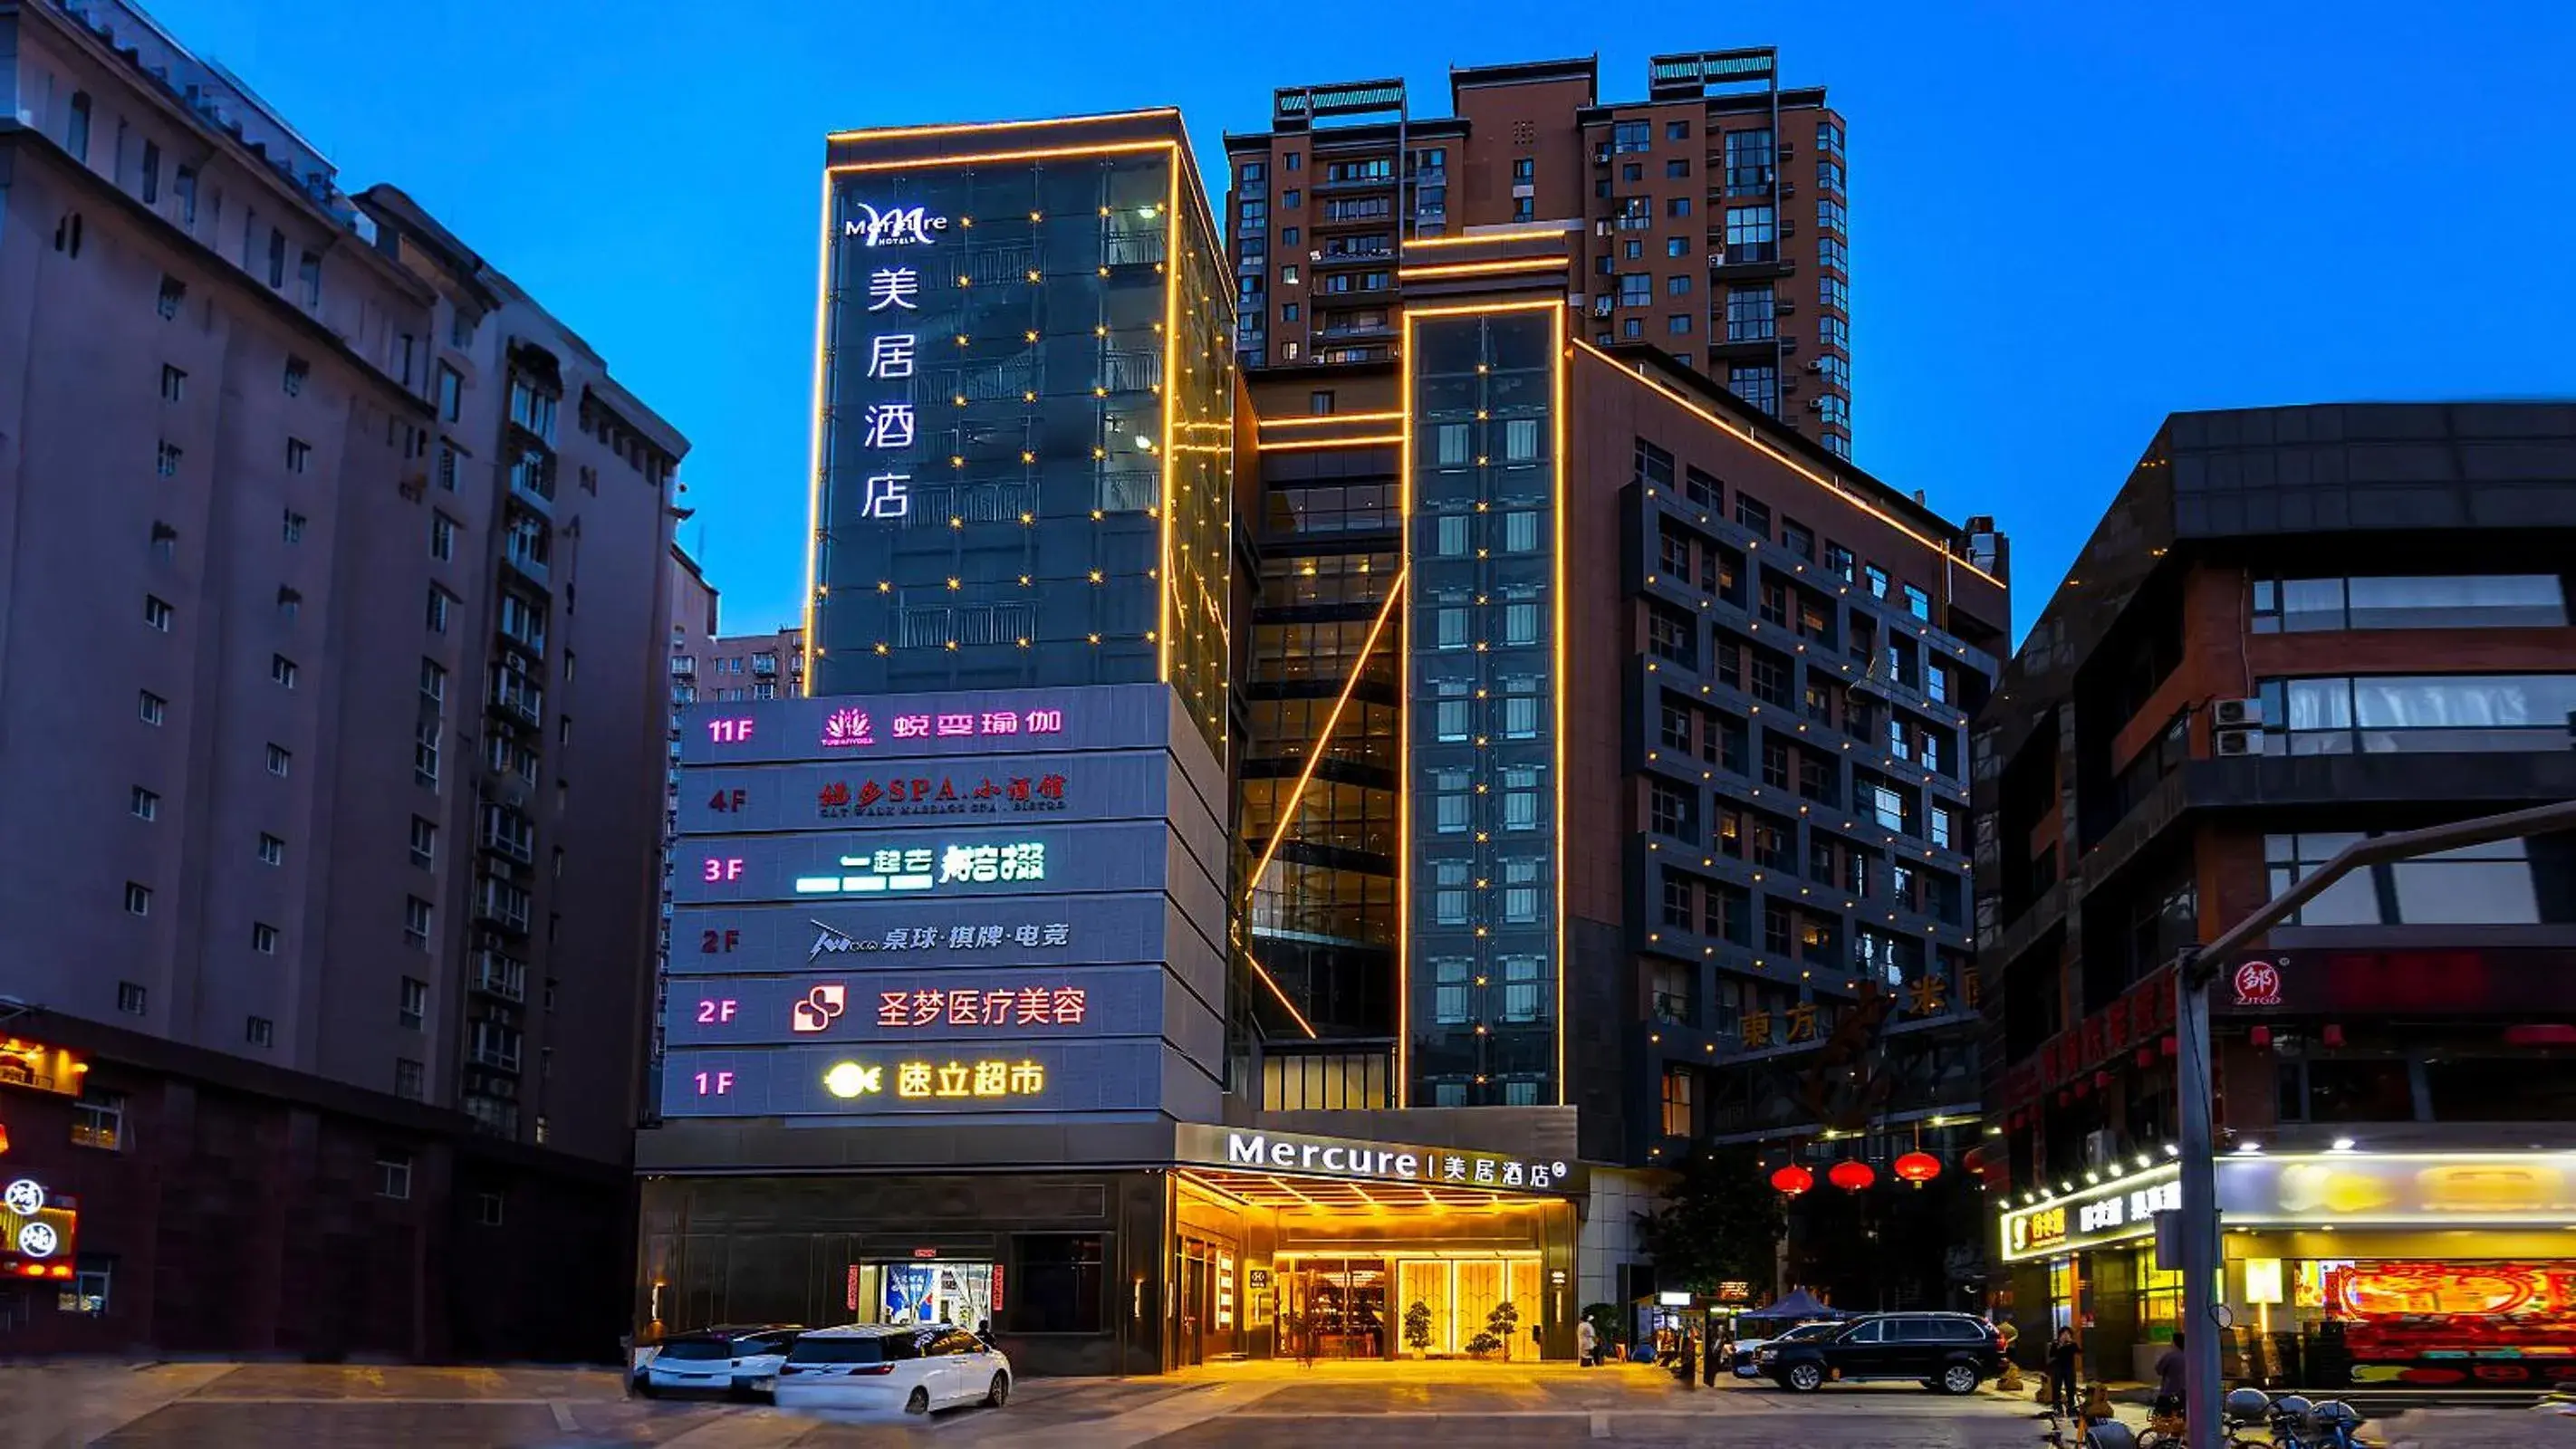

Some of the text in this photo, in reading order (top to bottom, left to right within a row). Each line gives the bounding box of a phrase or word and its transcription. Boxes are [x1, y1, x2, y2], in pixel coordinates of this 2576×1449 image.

[862, 267, 918, 519] 美居酒店
[708, 719, 754, 743] 11F
[708, 789, 746, 813] 4F
[705, 859, 744, 881] 3F
[701, 930, 740, 954] 2F
[697, 1000, 737, 1023] 2F
[876, 988, 1085, 1026] 圣梦医疗美容
[694, 1071, 733, 1095] 1F
[898, 1060, 1044, 1097] 速立超市
[1228, 1134, 1549, 1187] Mercure 美居酒店
